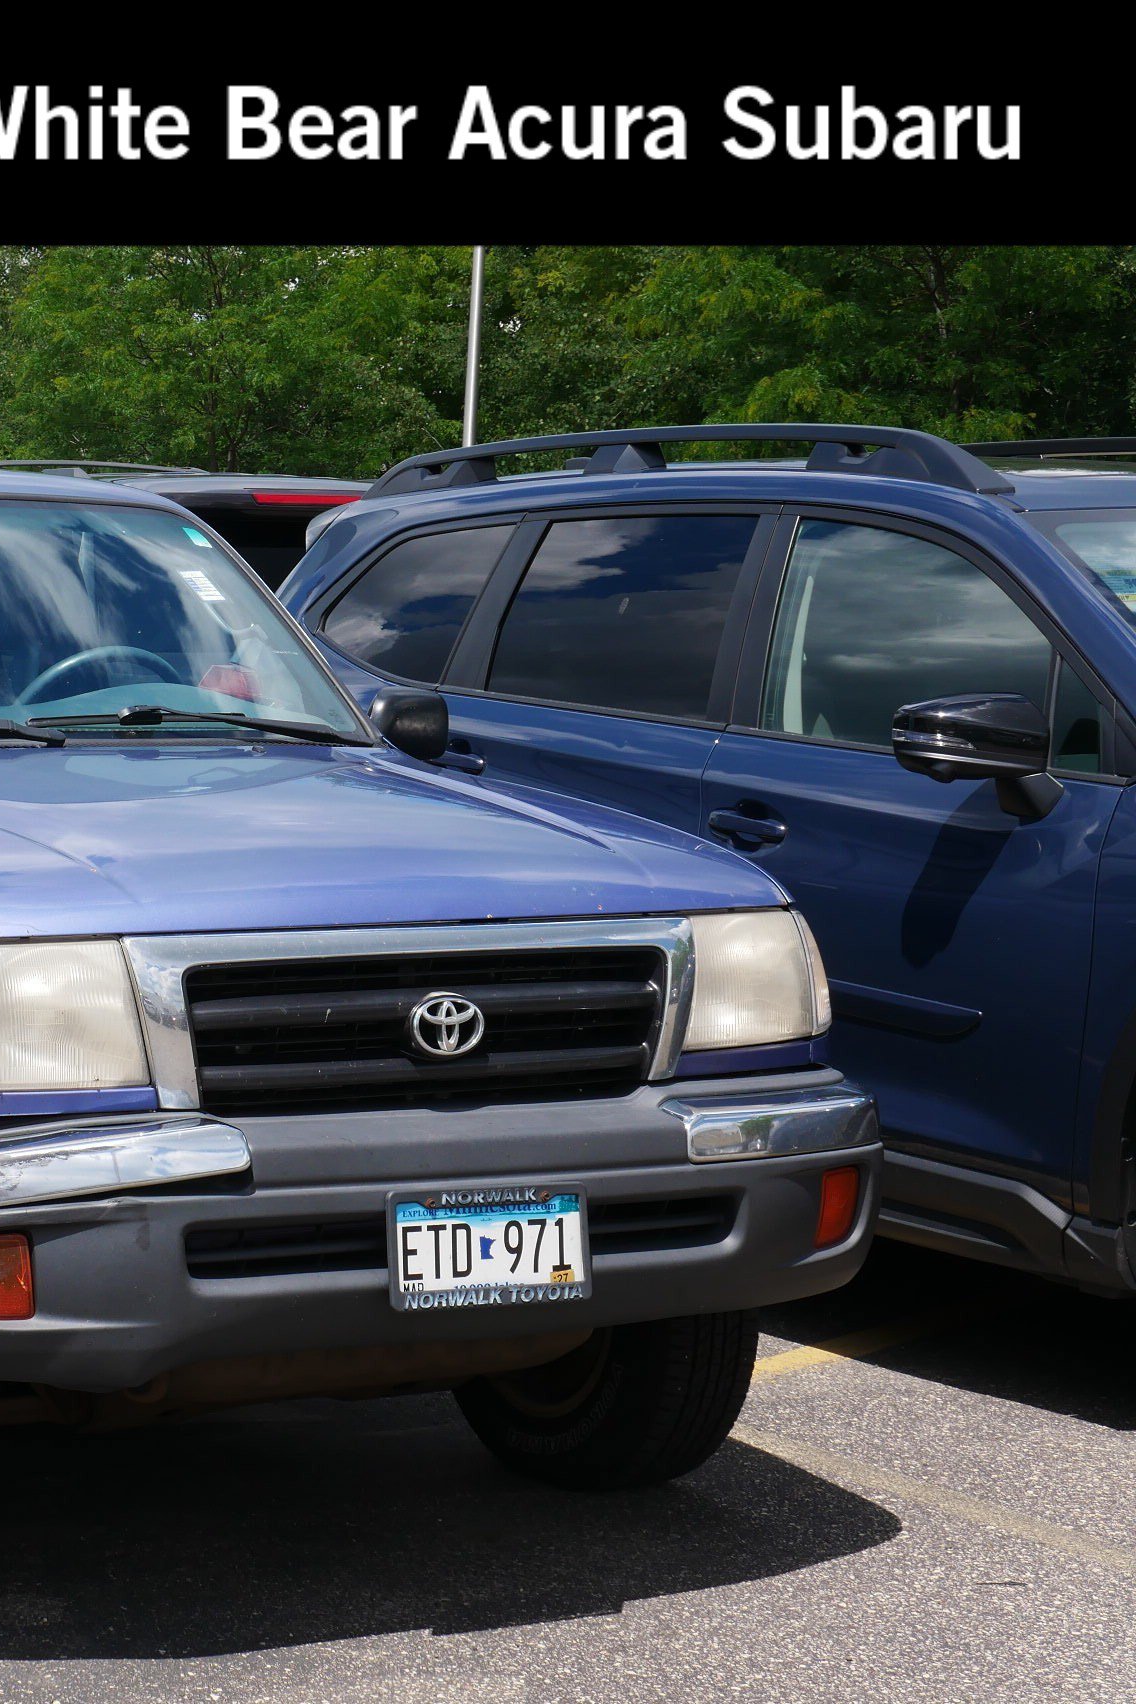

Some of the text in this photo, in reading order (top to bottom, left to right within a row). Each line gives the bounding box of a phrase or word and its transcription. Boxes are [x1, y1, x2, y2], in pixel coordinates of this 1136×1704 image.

[441, 1187, 537, 1206] NORWALK
[402, 1218, 572, 1281] ETD 971
[405, 1284, 584, 1310] NORWALK TOYOTA
